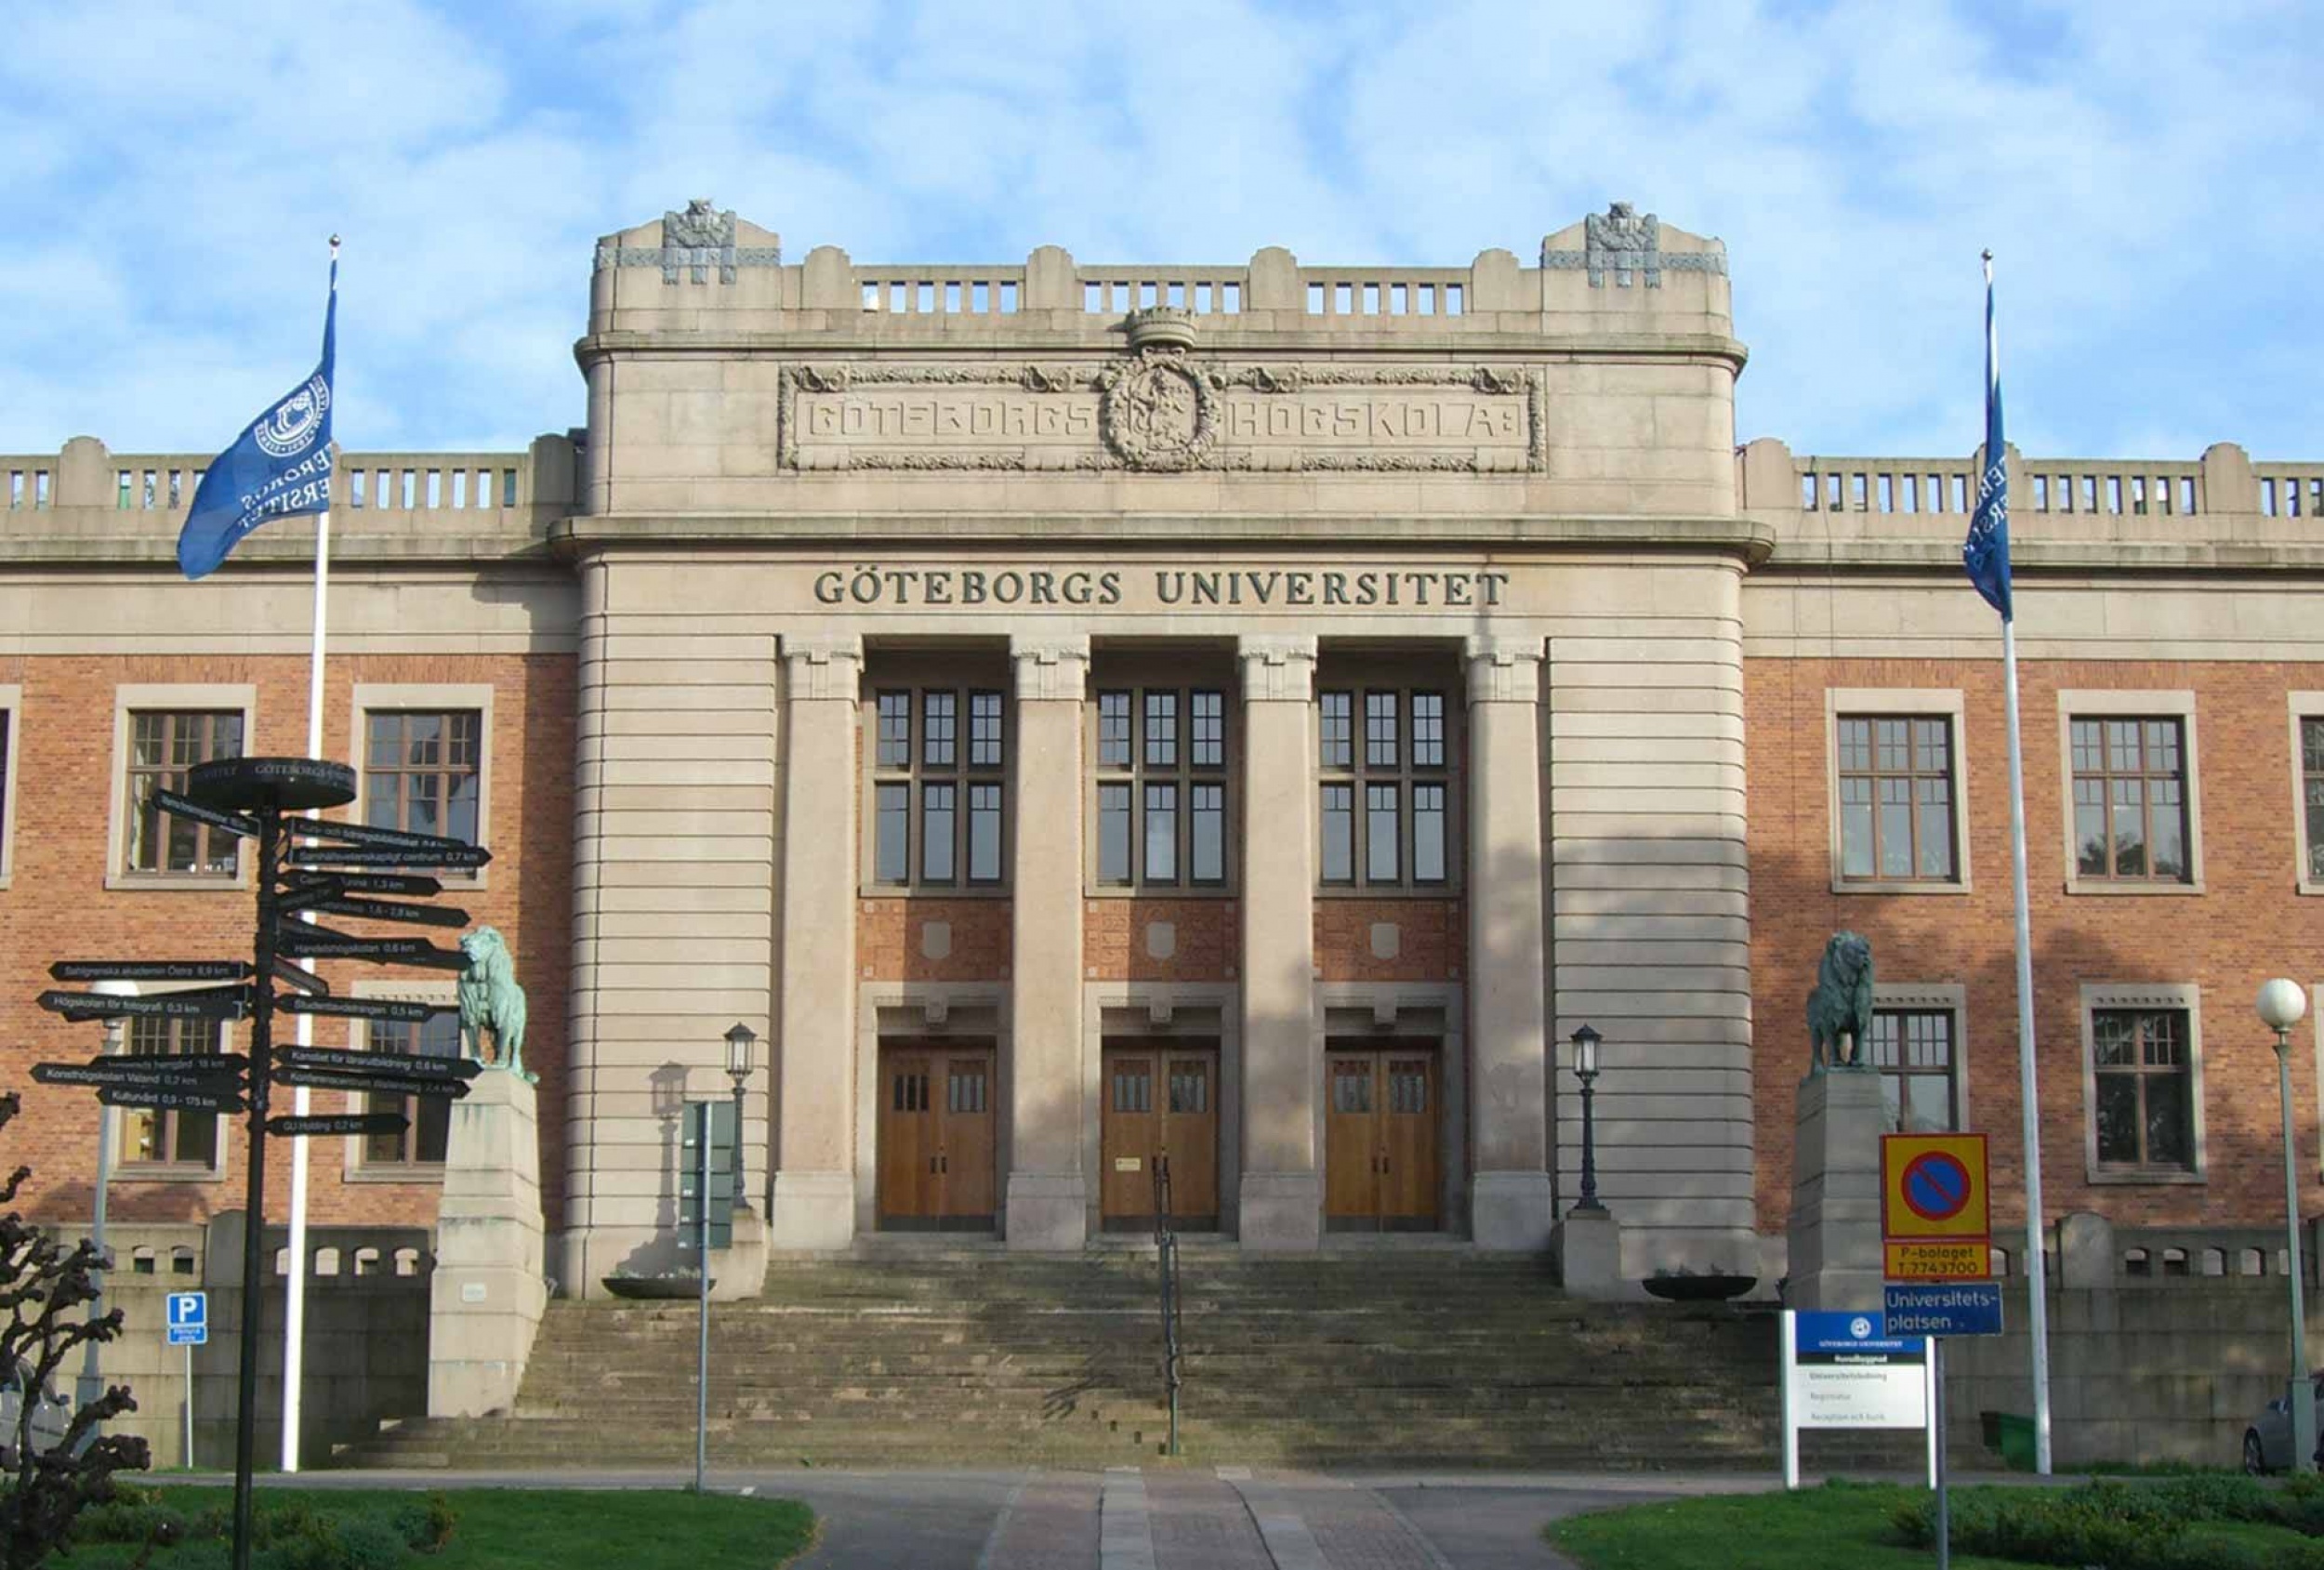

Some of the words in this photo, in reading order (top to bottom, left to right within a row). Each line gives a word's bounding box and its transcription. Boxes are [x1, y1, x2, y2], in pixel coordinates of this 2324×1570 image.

[813, 564, 1122, 604] GÖTEBORGS
[1155, 571, 1510, 605] UNIVERSITET
[1900, 1247, 1974, 1260] P-bolaget
[1886, 1290, 1999, 1308] Universitets-
[178, 1297, 197, 1322] P
[1887, 1313, 1952, 1332] platsen
